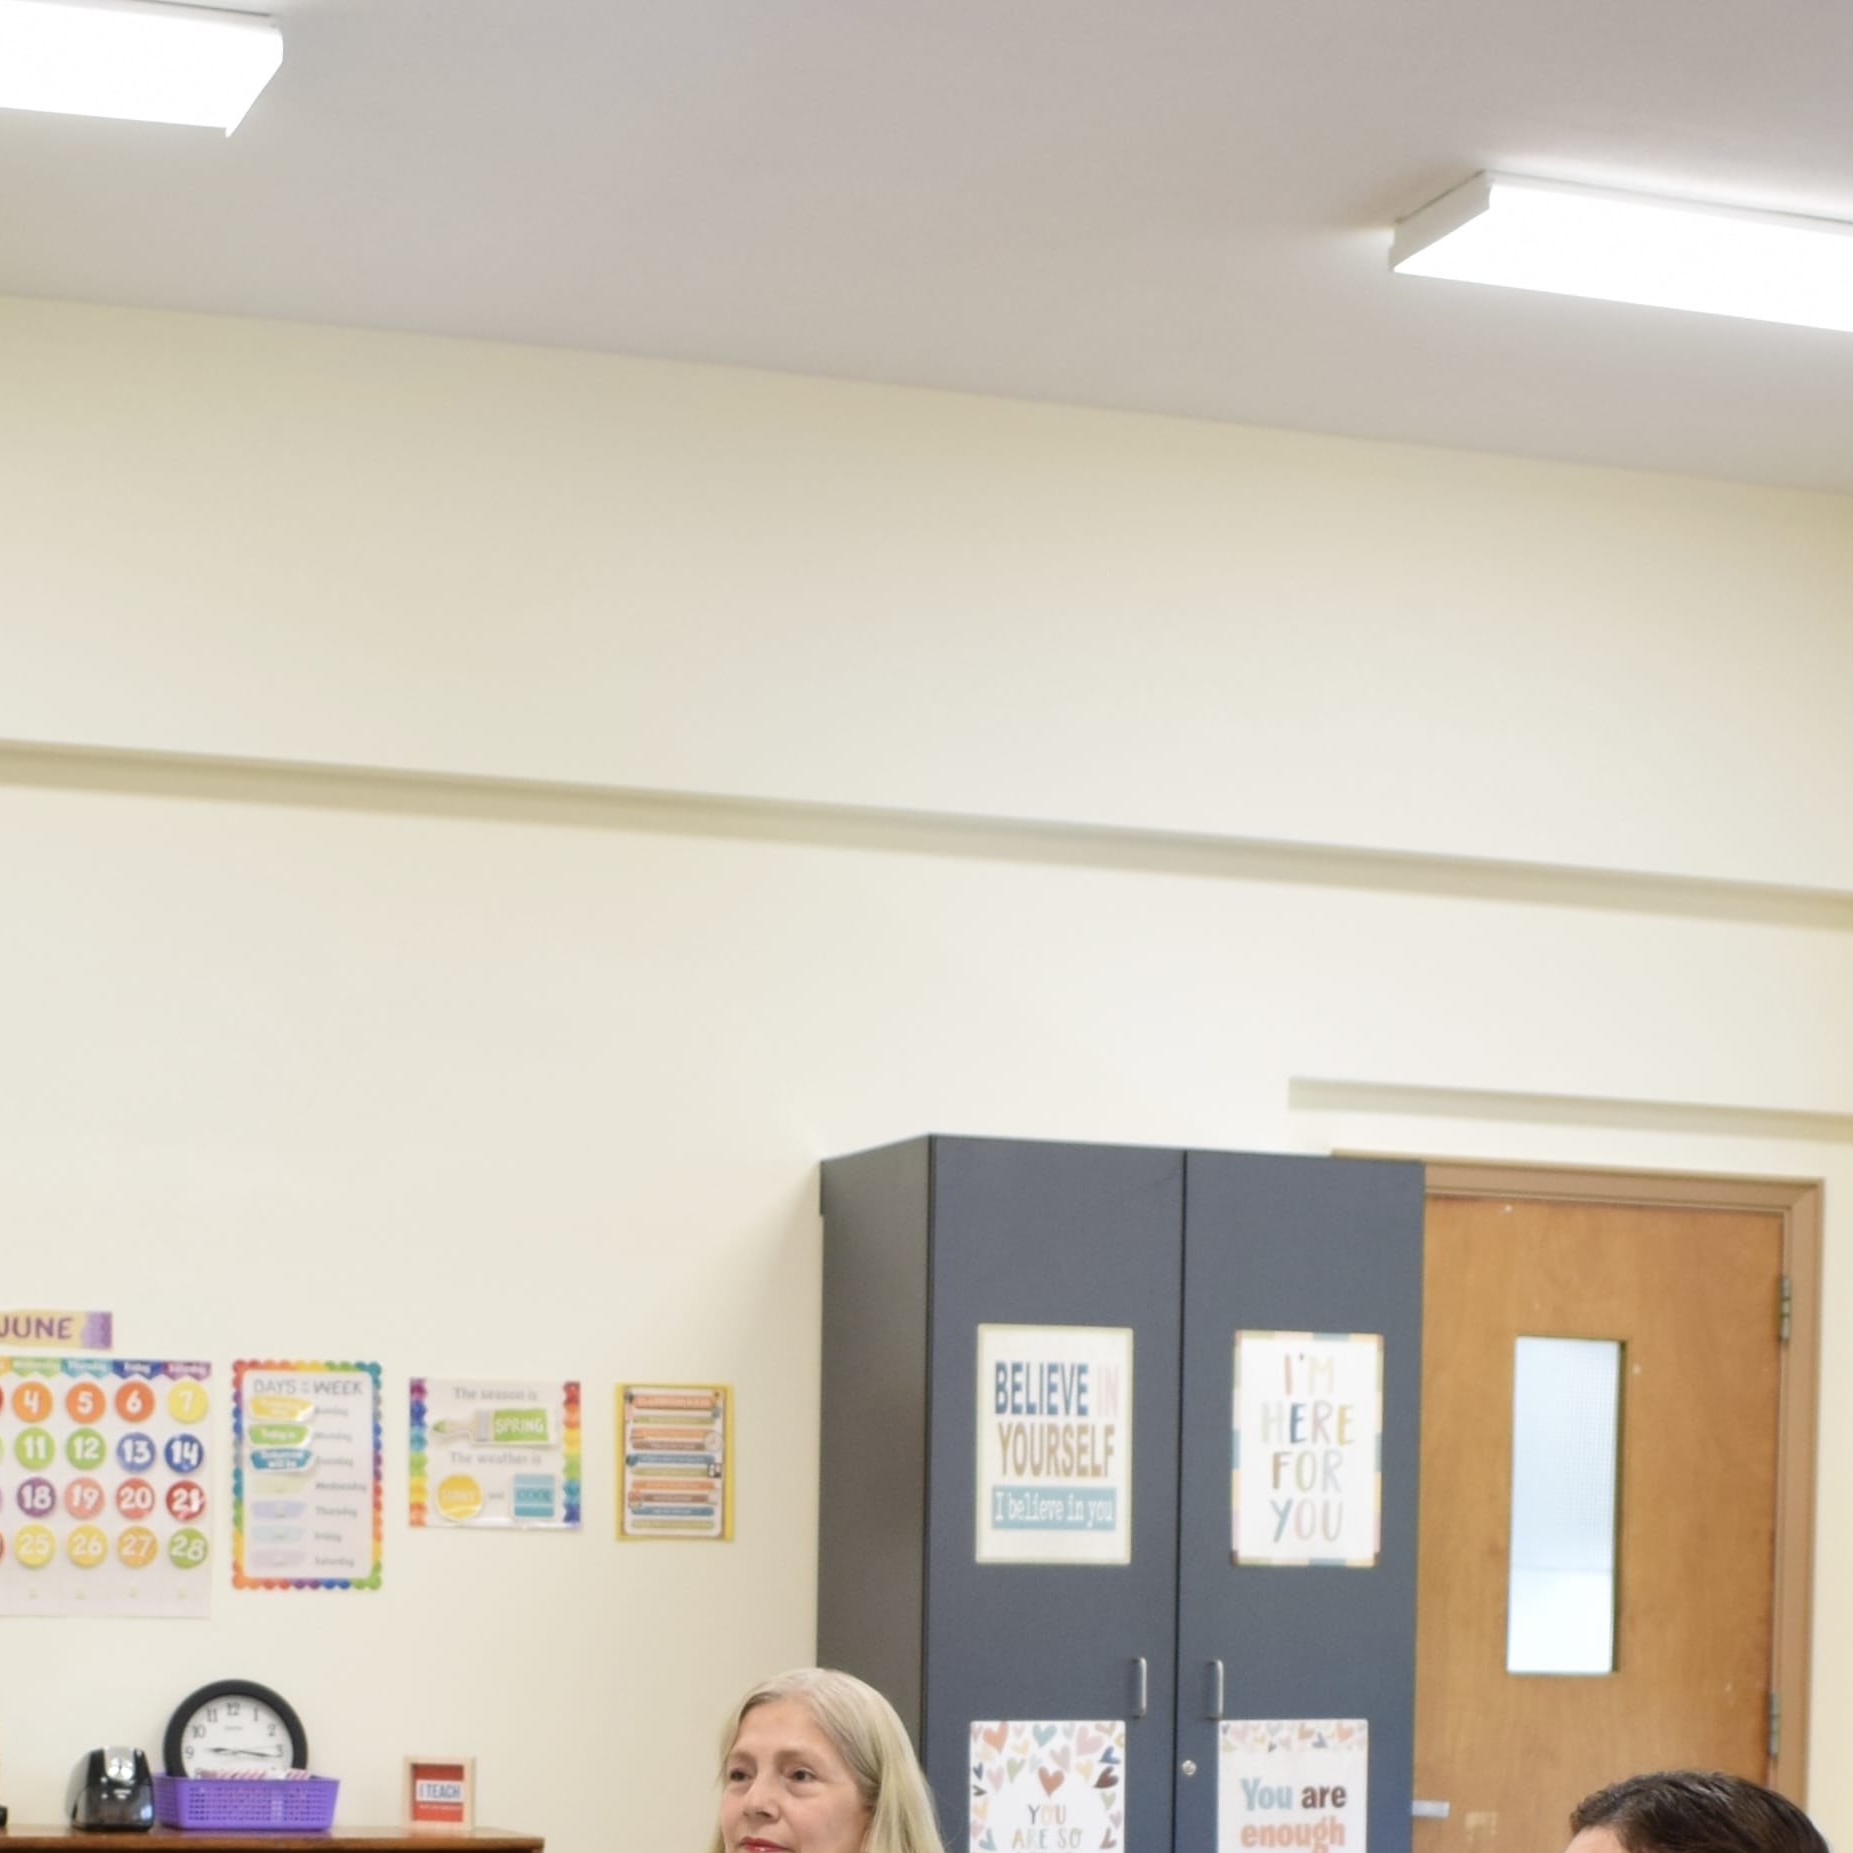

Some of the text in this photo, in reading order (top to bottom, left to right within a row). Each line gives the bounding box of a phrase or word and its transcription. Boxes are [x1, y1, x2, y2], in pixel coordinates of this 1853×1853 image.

[253, 1379, 296, 1395] DAYS
[312, 1380, 363, 1395] WEEK
[1284, 1353, 1334, 1396] I'M
[454, 1387, 477, 1400] The
[995, 1360, 1120, 1416] BELIEVE IN
[23, 1391, 39, 1413] 4
[77, 1391, 93, 1414] 5
[126, 1390, 142, 1413] 6
[179, 1392, 194, 1413] 7
[496, 1417, 547, 1433] SPRING
[1260, 1399, 1355, 1446] HERE
[24, 1437, 46, 1459] 11
[73, 1437, 99, 1460] 12
[122, 1442, 151, 1465] 13
[171, 1442, 198, 1466] 14
[450, 1452, 473, 1464] The
[997, 1421, 1115, 1477] YOURSELF
[1272, 1449, 1344, 1493] FOR
[21, 1485, 52, 1509] 18
[73, 1485, 96, 1509] 19
[121, 1486, 153, 1510] 20
[172, 1488, 200, 1512] 21
[994, 1491, 1114, 1529] I believe in you
[1270, 1497, 1344, 1543] YOU
[19, 1534, 50, 1556] 25
[73, 1534, 102, 1557] 26
[122, 1534, 153, 1556] 27
[171, 1536, 204, 1560] 28
[226, 1702, 240, 1716] 12
[192, 1724, 206, 1738] 10
[267, 1723, 276, 1736] 2
[185, 1745, 194, 1759] 9
[1240, 1776, 1347, 1811] You are
[1027, 1803, 1067, 1825] YOU
[1012, 1827, 1084, 1849] ARE SO
